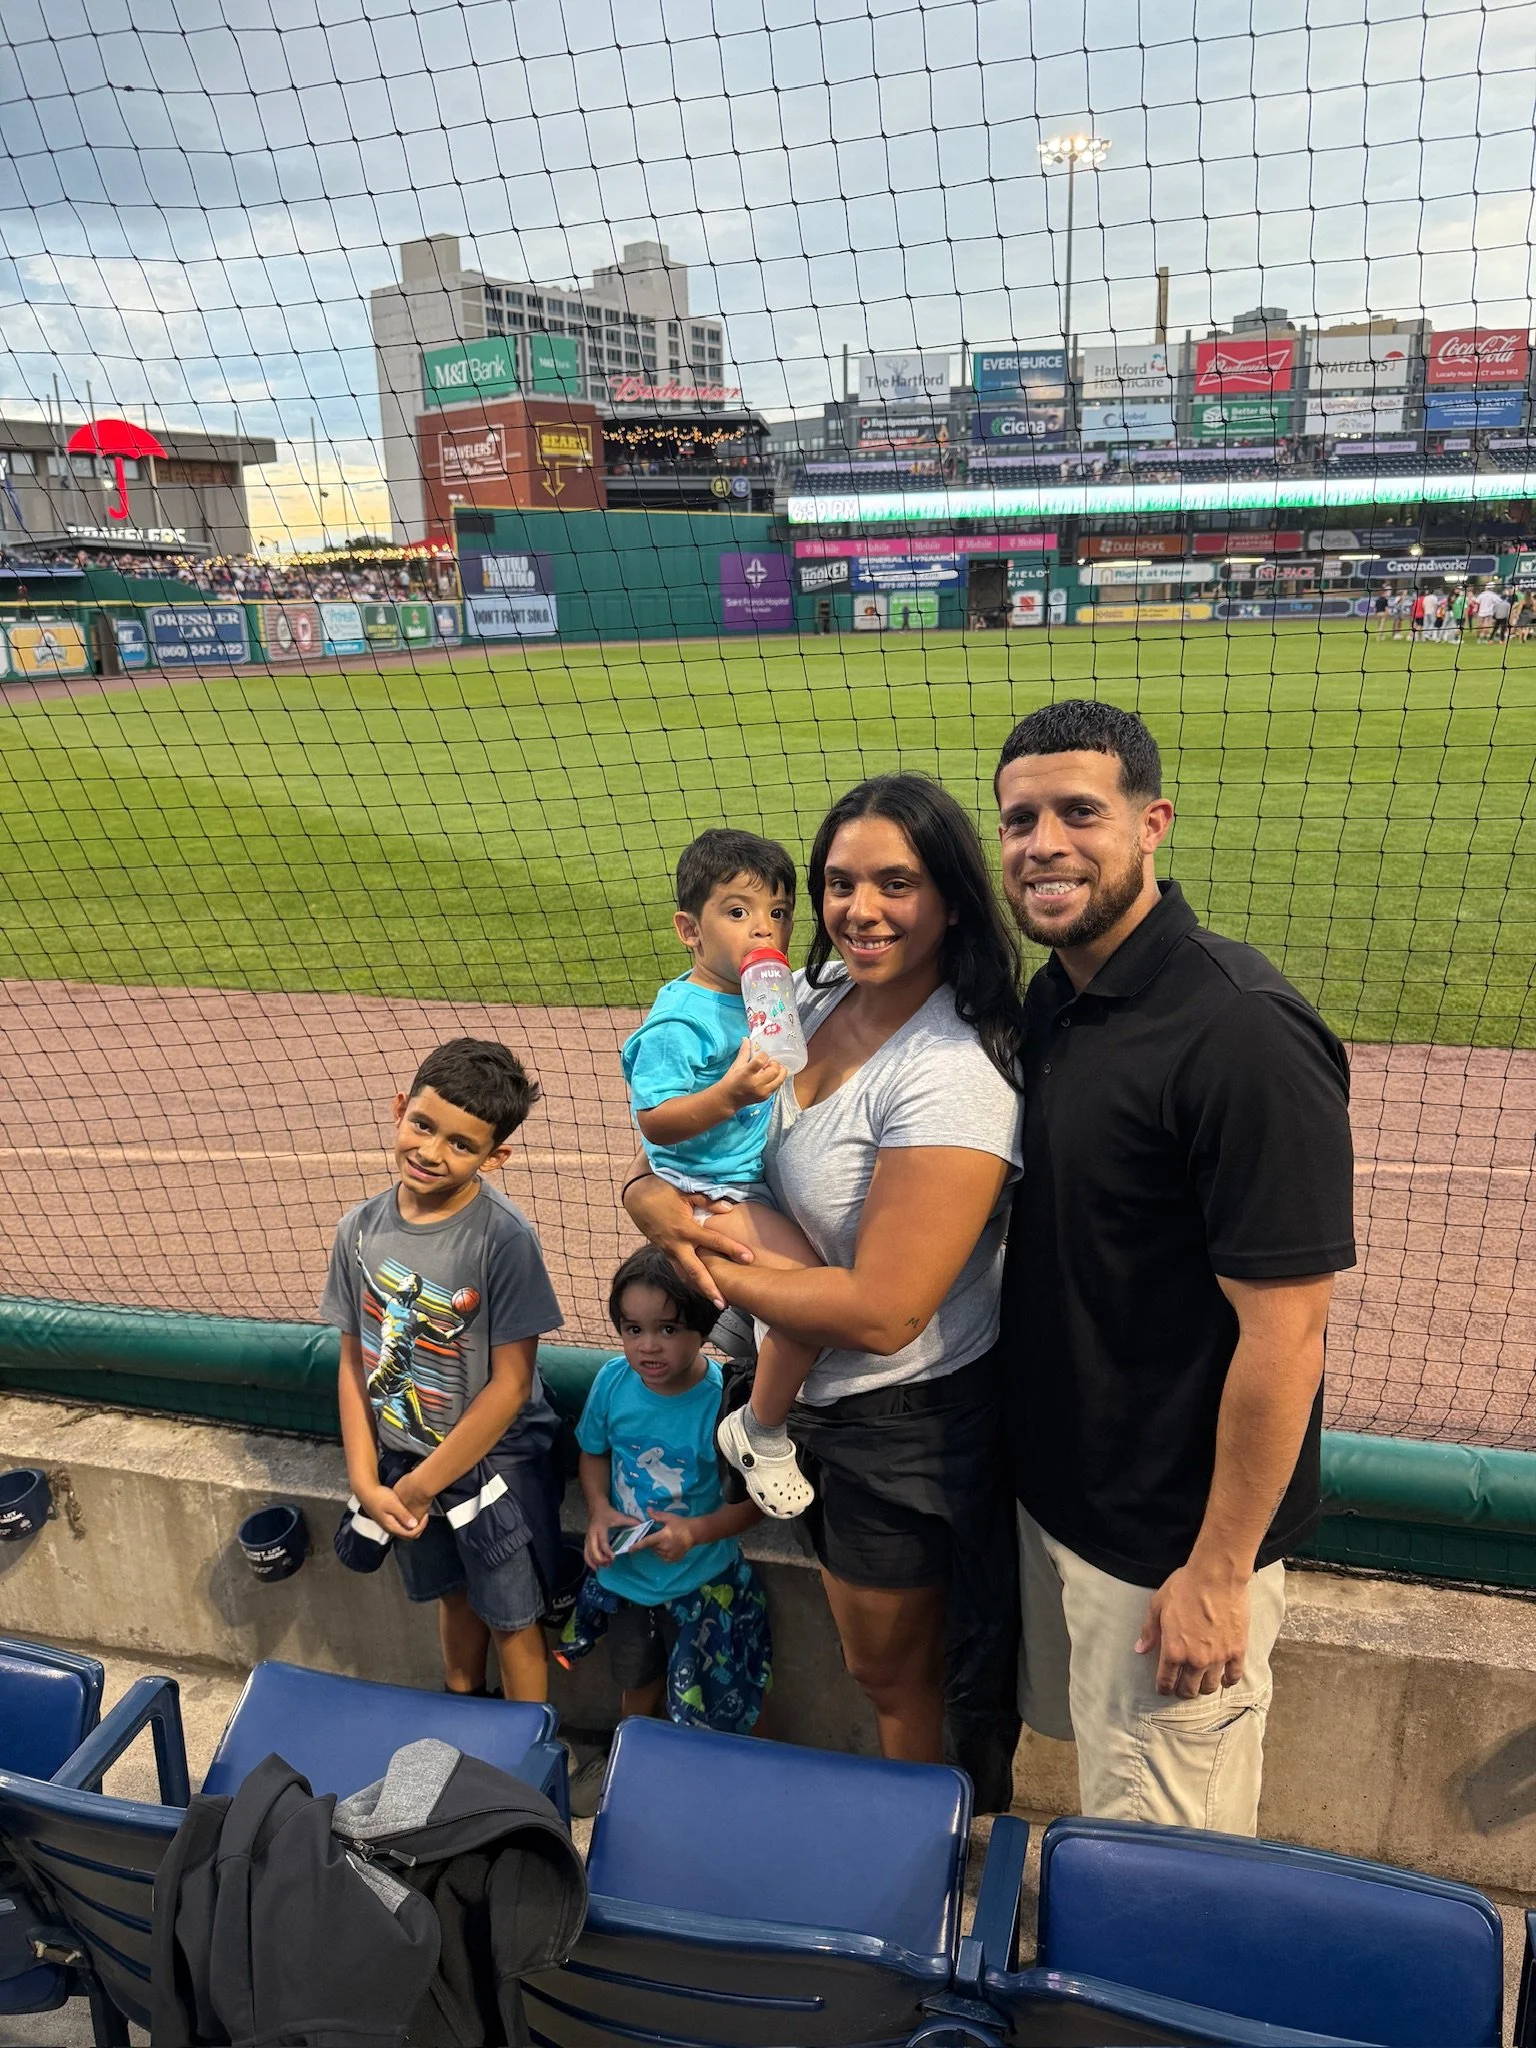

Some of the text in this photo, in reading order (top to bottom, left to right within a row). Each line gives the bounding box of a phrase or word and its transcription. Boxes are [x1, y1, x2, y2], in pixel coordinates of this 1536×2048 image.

[983, 356, 1063, 371] EVERSOURCE
[1095, 362, 1147, 376] Hartford
[433, 354, 506, 388] M&T Bank
[865, 373, 944, 389] The Hartford
[609, 376, 742, 402] Budweiser
[1231, 407, 1258, 415] Better
[801, 561, 848, 588] HOOKER
[153, 613, 240, 627] DRESSLER
[178, 626, 217, 639] LAW
[760, 970, 782, 979] NUK
[766, 1024, 777, 1032] 95
